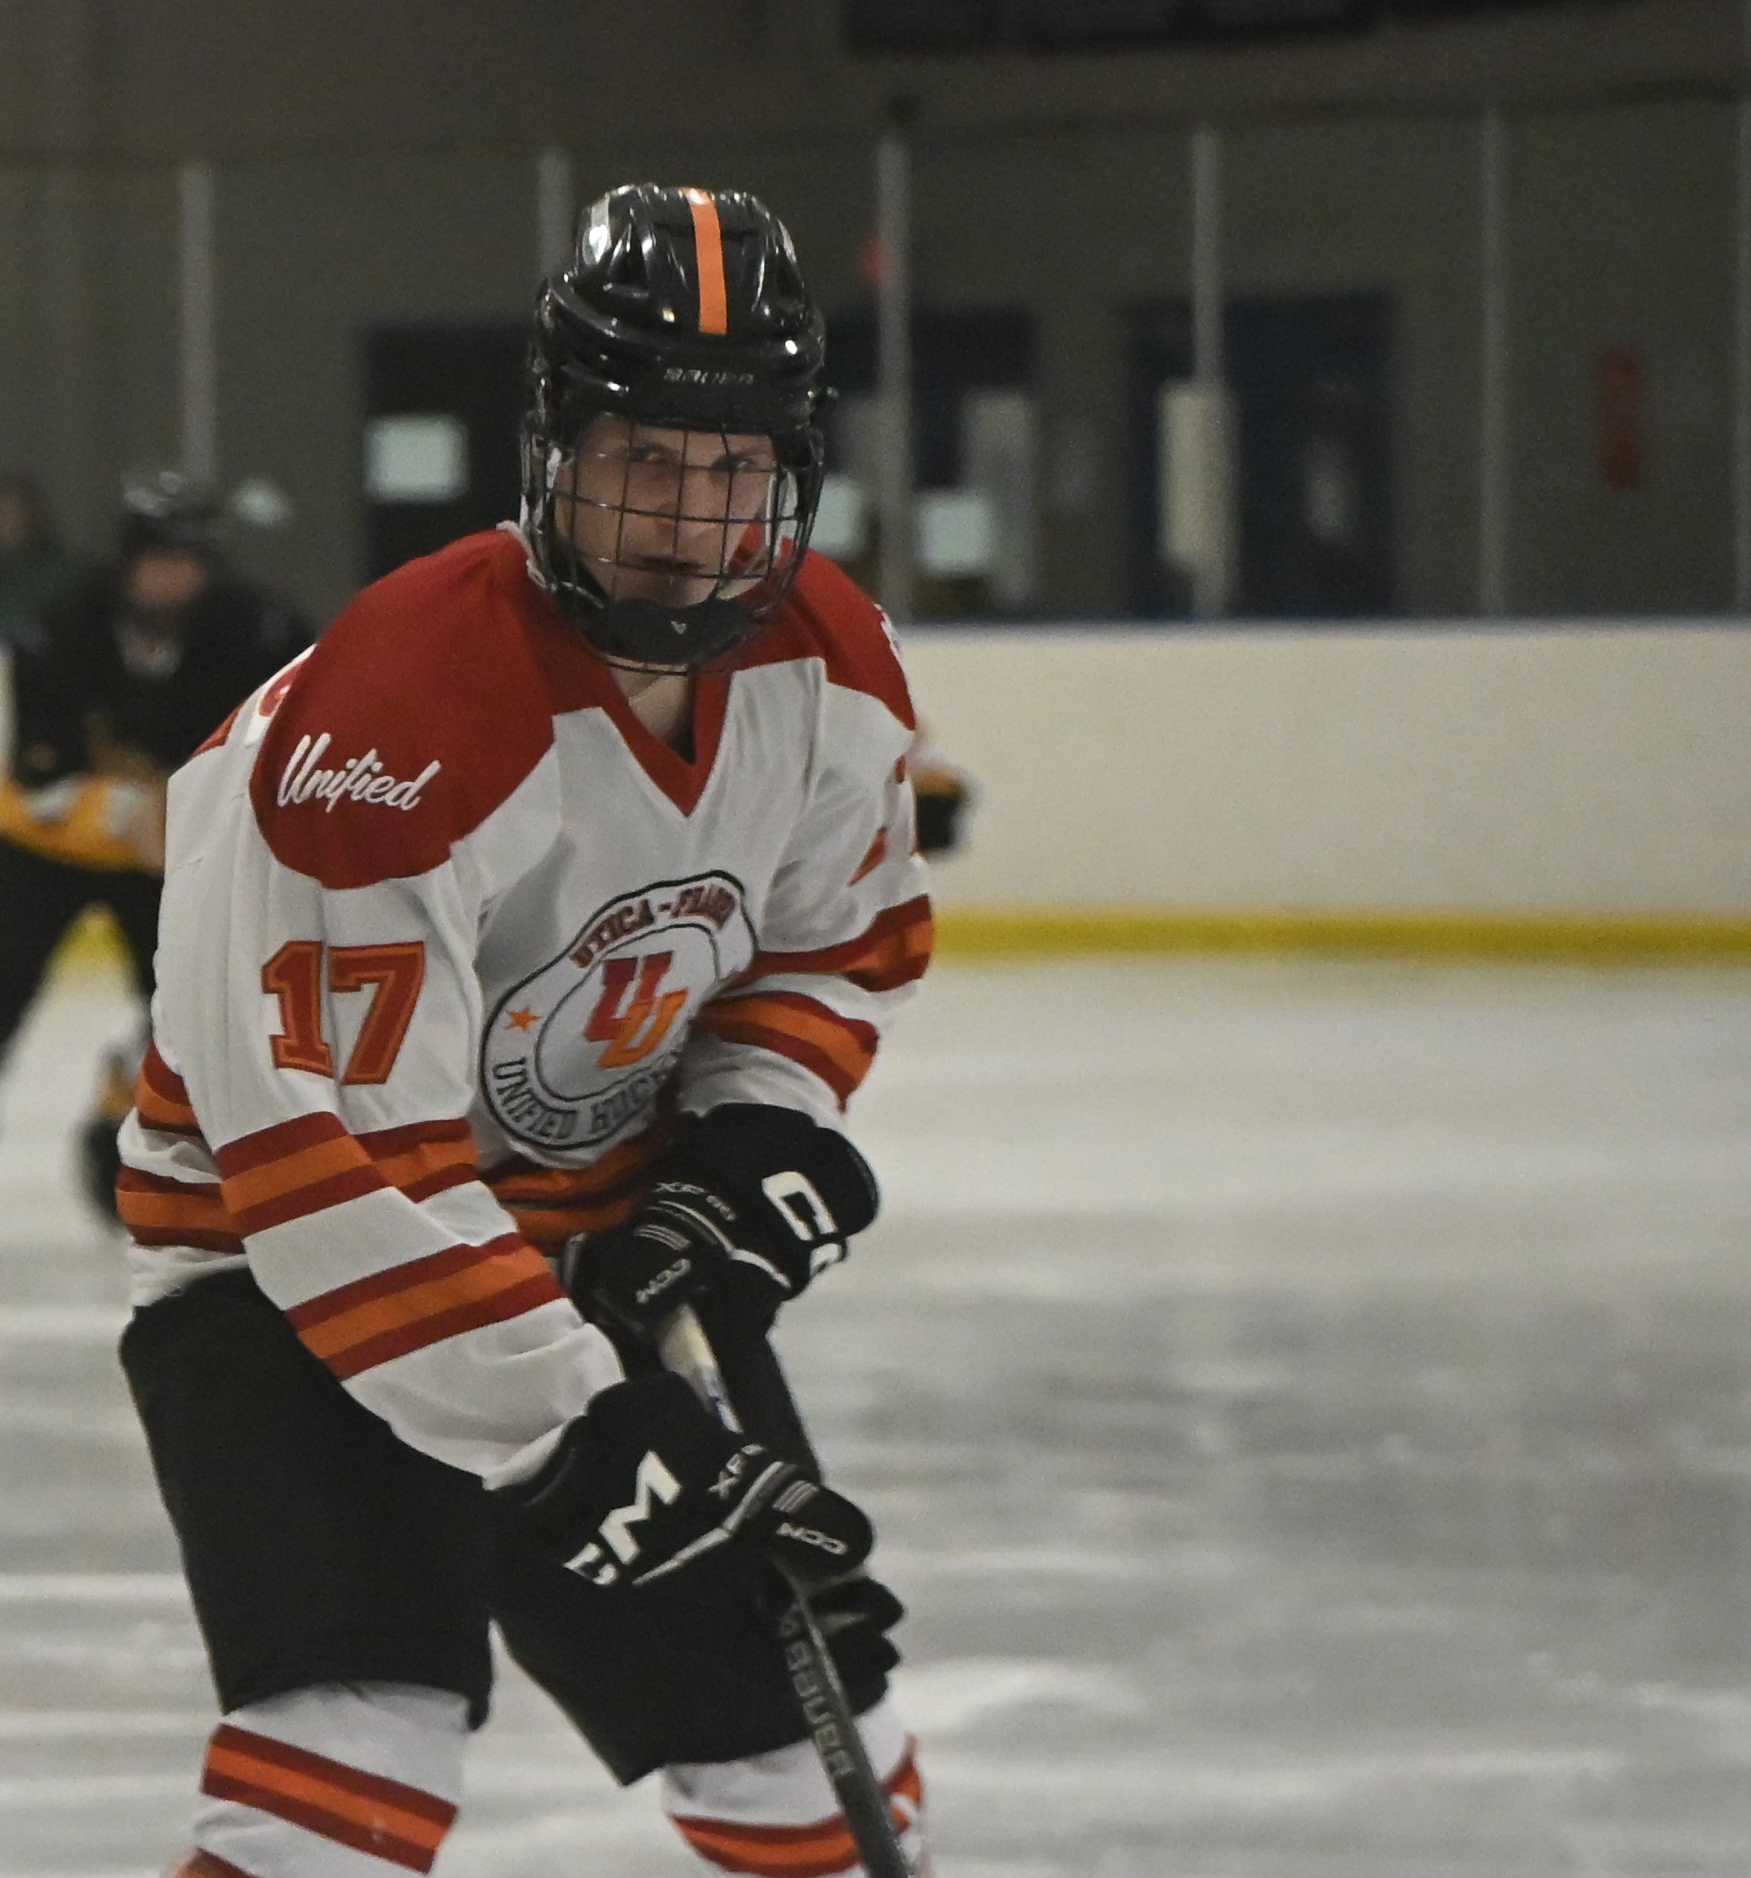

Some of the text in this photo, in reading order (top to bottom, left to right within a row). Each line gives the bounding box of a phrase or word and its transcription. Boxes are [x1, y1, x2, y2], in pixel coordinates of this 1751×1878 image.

[277, 732, 442, 813] Unified
[260, 939, 426, 1085] 17
[775, 1520, 849, 1557] CCM
[783, 1637, 857, 1780] BAUER
